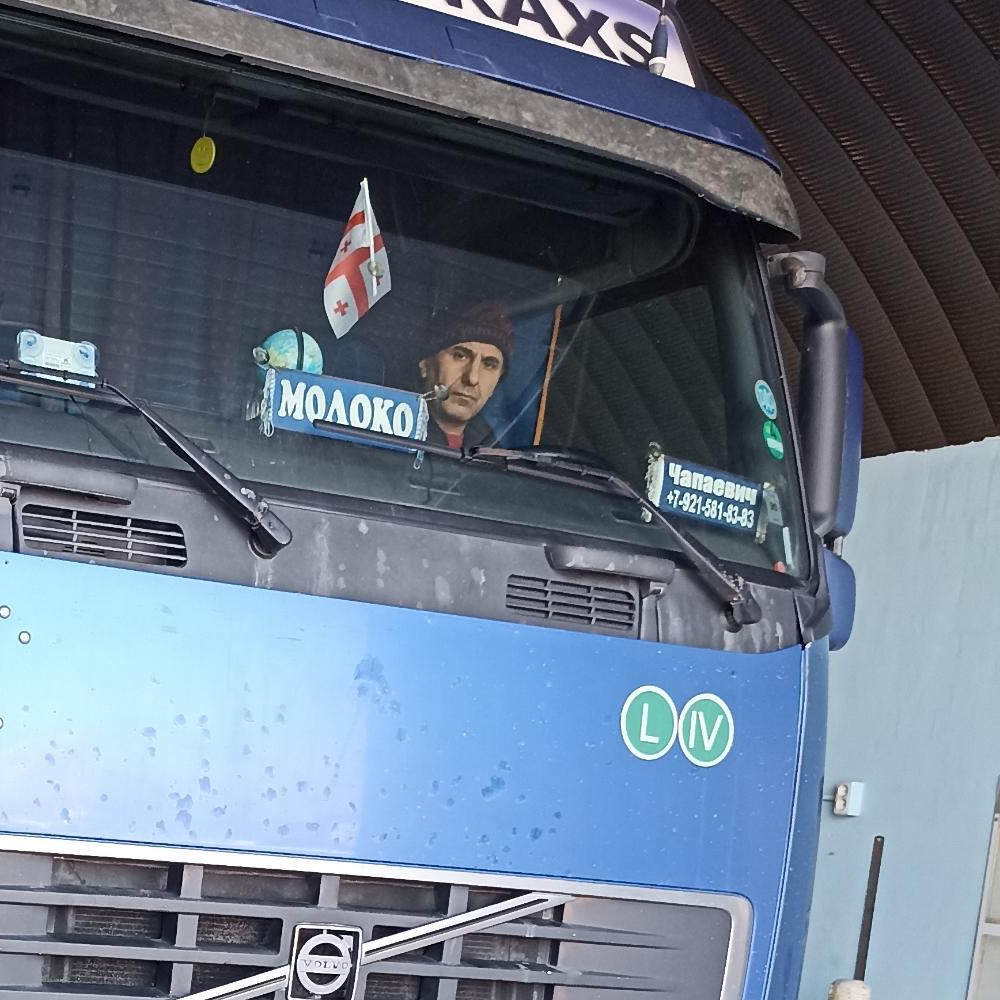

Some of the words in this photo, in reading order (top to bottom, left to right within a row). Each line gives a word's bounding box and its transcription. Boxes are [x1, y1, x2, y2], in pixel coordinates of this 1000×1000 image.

[441, 0, 652, 68] AXS
[278, 379, 414, 438] МОЛОКО
[668, 462, 758, 505] Чапаевич
[666, 489, 755, 529] +7-921-581-83-83
[640, 703, 659, 743] L
[689, 710, 723, 750] IV
[302, 959, 349, 969] VOLVO
